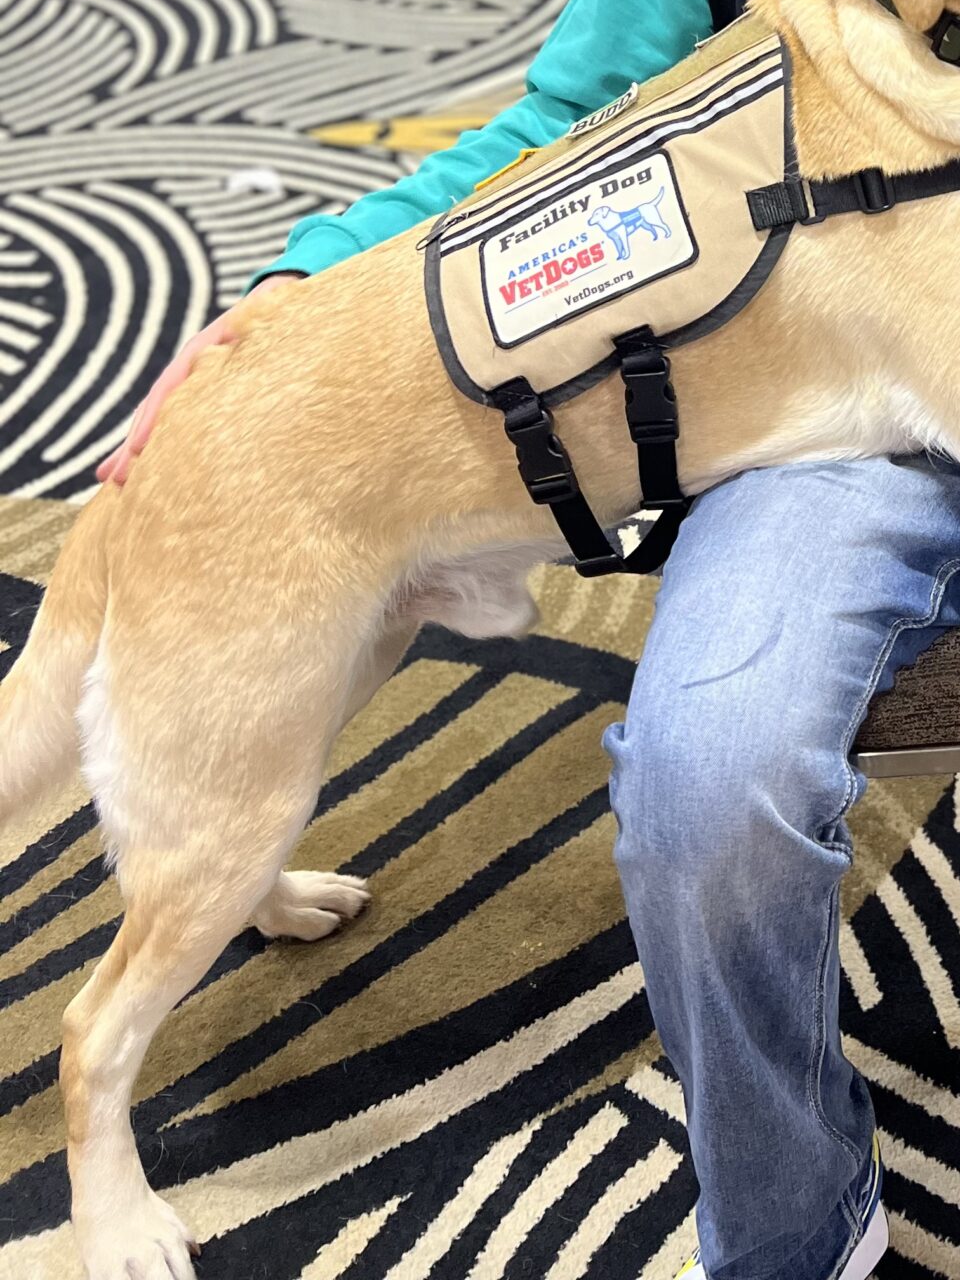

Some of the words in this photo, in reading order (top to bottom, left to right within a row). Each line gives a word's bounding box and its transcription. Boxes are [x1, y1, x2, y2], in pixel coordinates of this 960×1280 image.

[570, 92, 632, 134] BUDD
[499, 195, 591, 252] Facility
[599, 167, 652, 199] Dog
[508, 233, 588, 280] AMERICA'S
[564, 270, 634, 306] VetDogs.org
